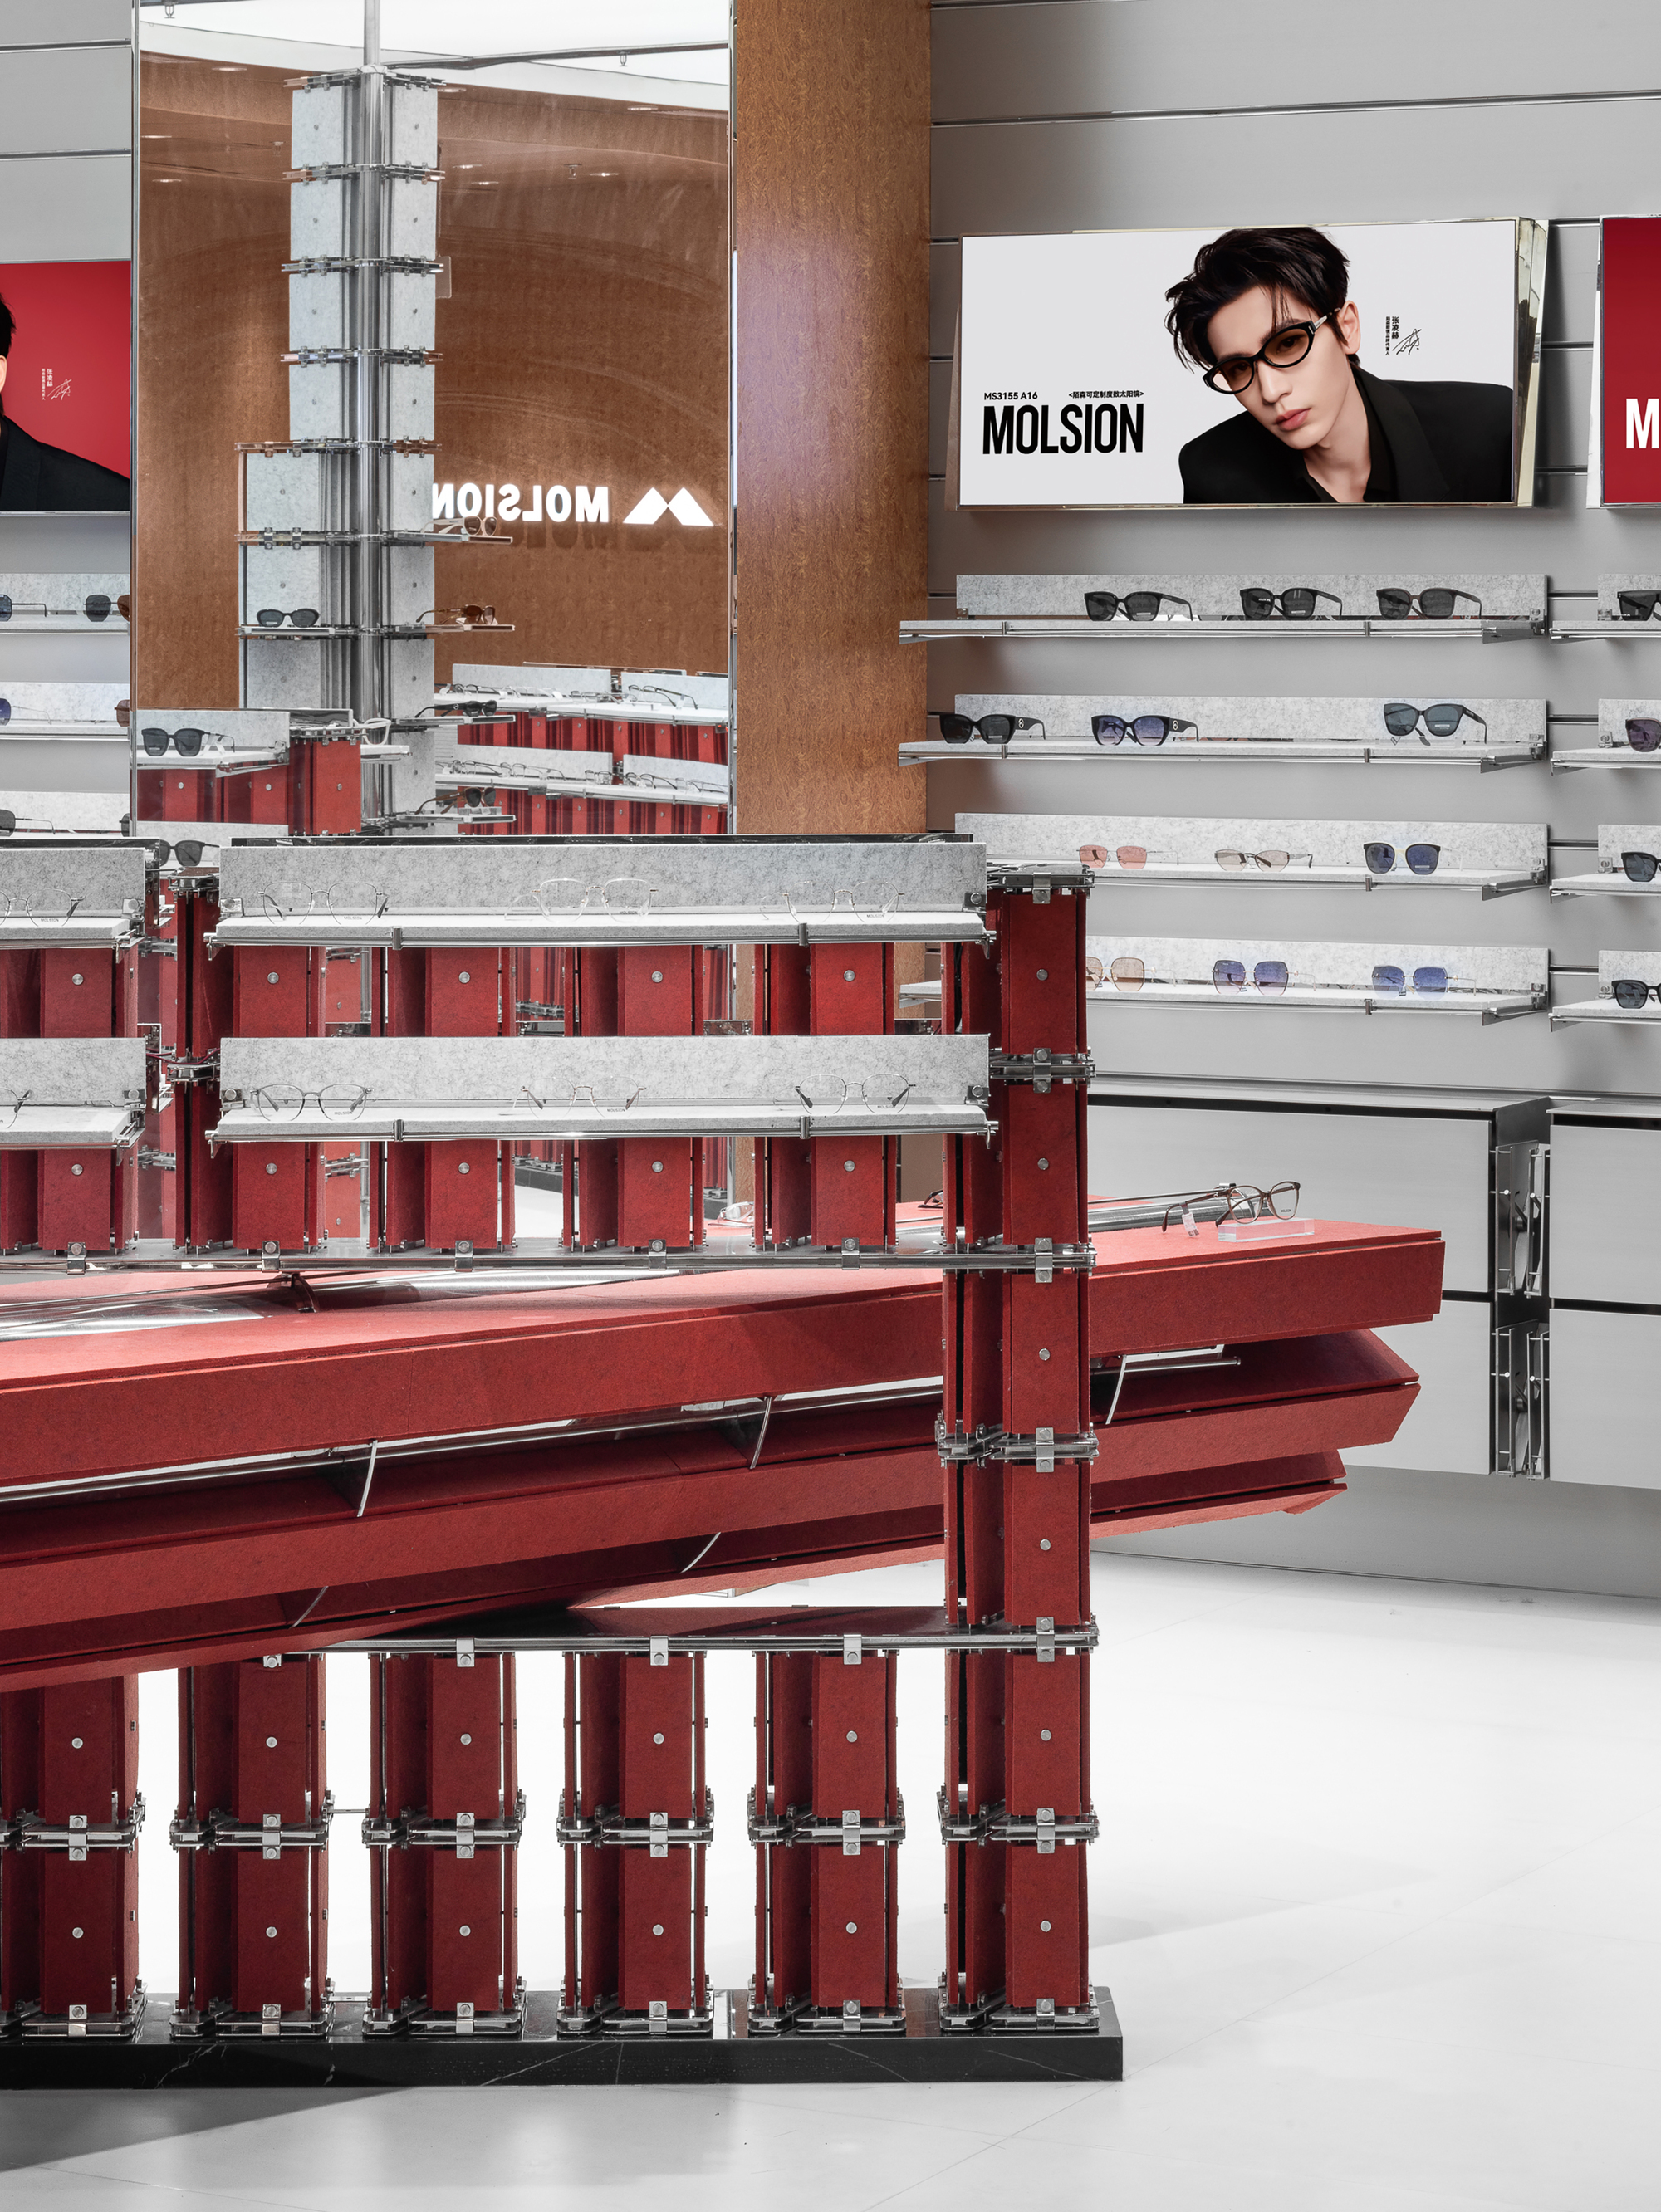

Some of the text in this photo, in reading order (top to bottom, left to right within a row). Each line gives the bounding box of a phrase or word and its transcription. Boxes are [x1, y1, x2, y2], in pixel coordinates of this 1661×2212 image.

[983, 391, 1038, 401] MS3155 A16
[982, 403, 1144, 455] MOLSION
